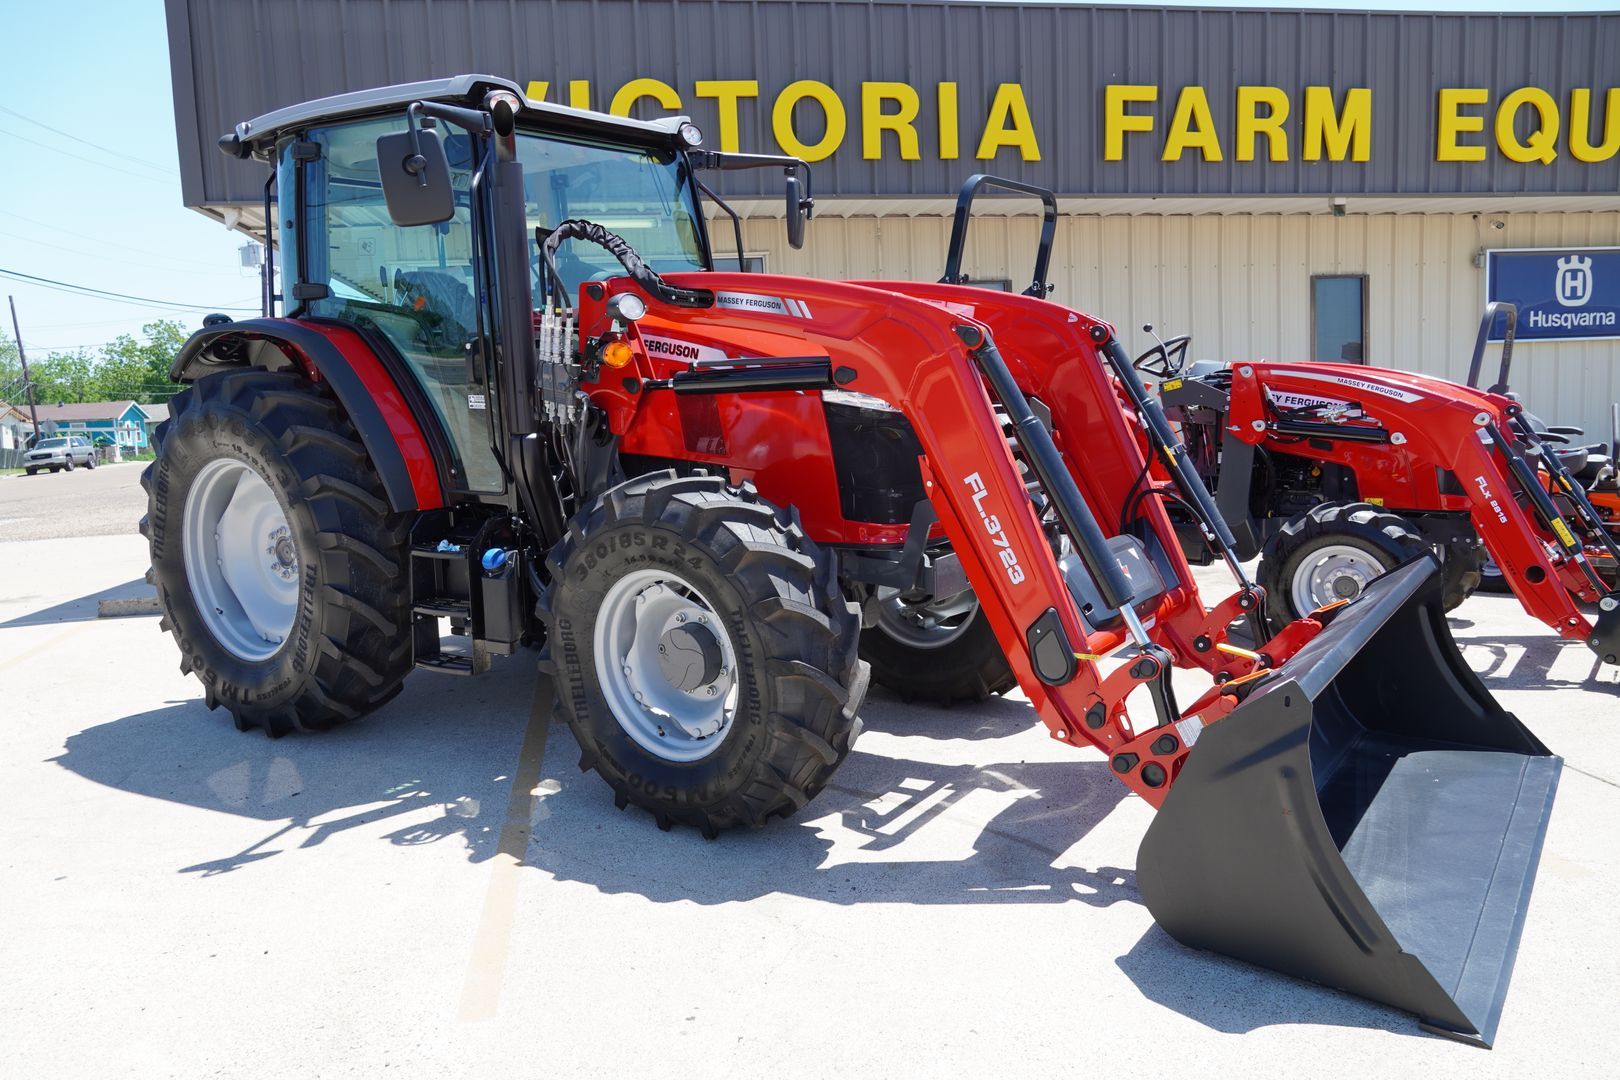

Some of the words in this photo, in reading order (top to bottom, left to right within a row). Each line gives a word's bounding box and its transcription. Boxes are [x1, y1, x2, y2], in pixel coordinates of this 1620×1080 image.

[526, 78, 1041, 162] TORIA
[1104, 84, 1372, 162] FARM
[1436, 86, 1620, 166] EQU
[717, 296, 744, 305] MASSEY
[745, 298, 782, 310] FERGUSON
[1529, 310, 1616, 330] Husqvarna
[1336, 377, 1366, 388] MASSEY
[1366, 383, 1404, 398] FERGUSON
[153, 459, 169, 560] TRELLEBORG
[963, 471, 1025, 585] FL.3723
[292, 562, 318, 674] TRELLEBORG
[730, 606, 761, 726] TRELLEBORG
[559, 618, 590, 723] TRELLEBORG
